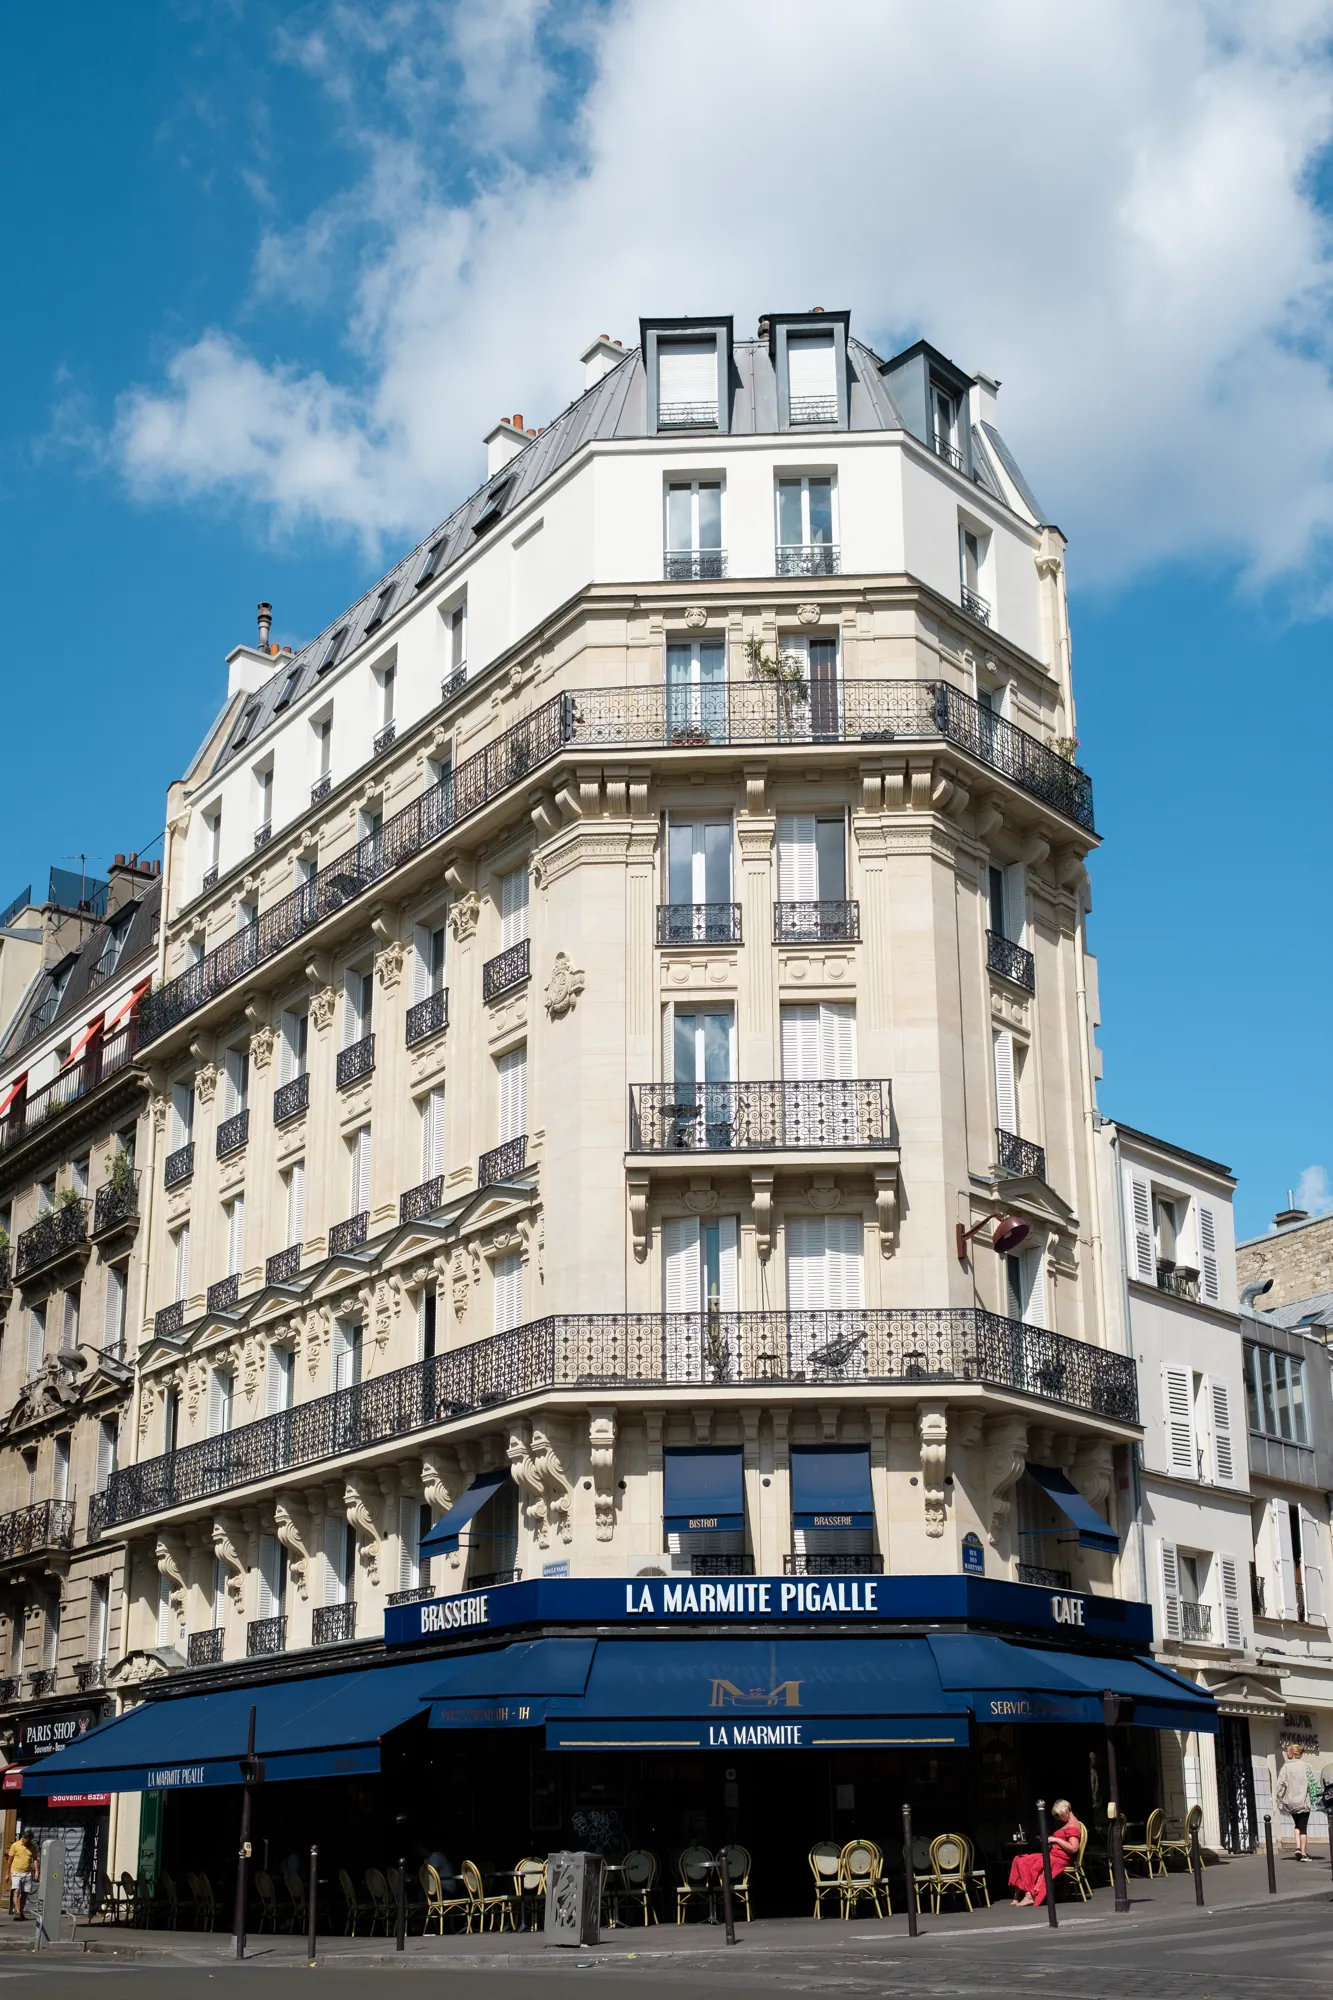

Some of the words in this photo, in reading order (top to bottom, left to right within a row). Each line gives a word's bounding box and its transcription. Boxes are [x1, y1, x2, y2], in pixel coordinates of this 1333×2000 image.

[689, 1518, 718, 1529] BISTROT
[814, 1516, 852, 1526] BRASSERIE
[626, 1584, 655, 1613] LA
[663, 1583, 772, 1613] MARMITE
[781, 1582, 878, 1612] PIGALLE
[420, 1595, 489, 1633] BRASSERIE
[1052, 1595, 1085, 1626] CAFE
[990, 1701, 1032, 1715] SERVICE
[26, 1723, 51, 1743] PARIS
[53, 1721, 76, 1740] SHOP
[709, 1726, 728, 1745] LA
[733, 1725, 803, 1745] MARMITE
[34, 1742, 52, 1754] Souvenir
[147, 1771, 155, 1787] LA
[156, 1768, 181, 1786] MARMITE
[181, 1766, 205, 1785] PIGALLE
[52, 1793, 83, 1802] Souvenir
